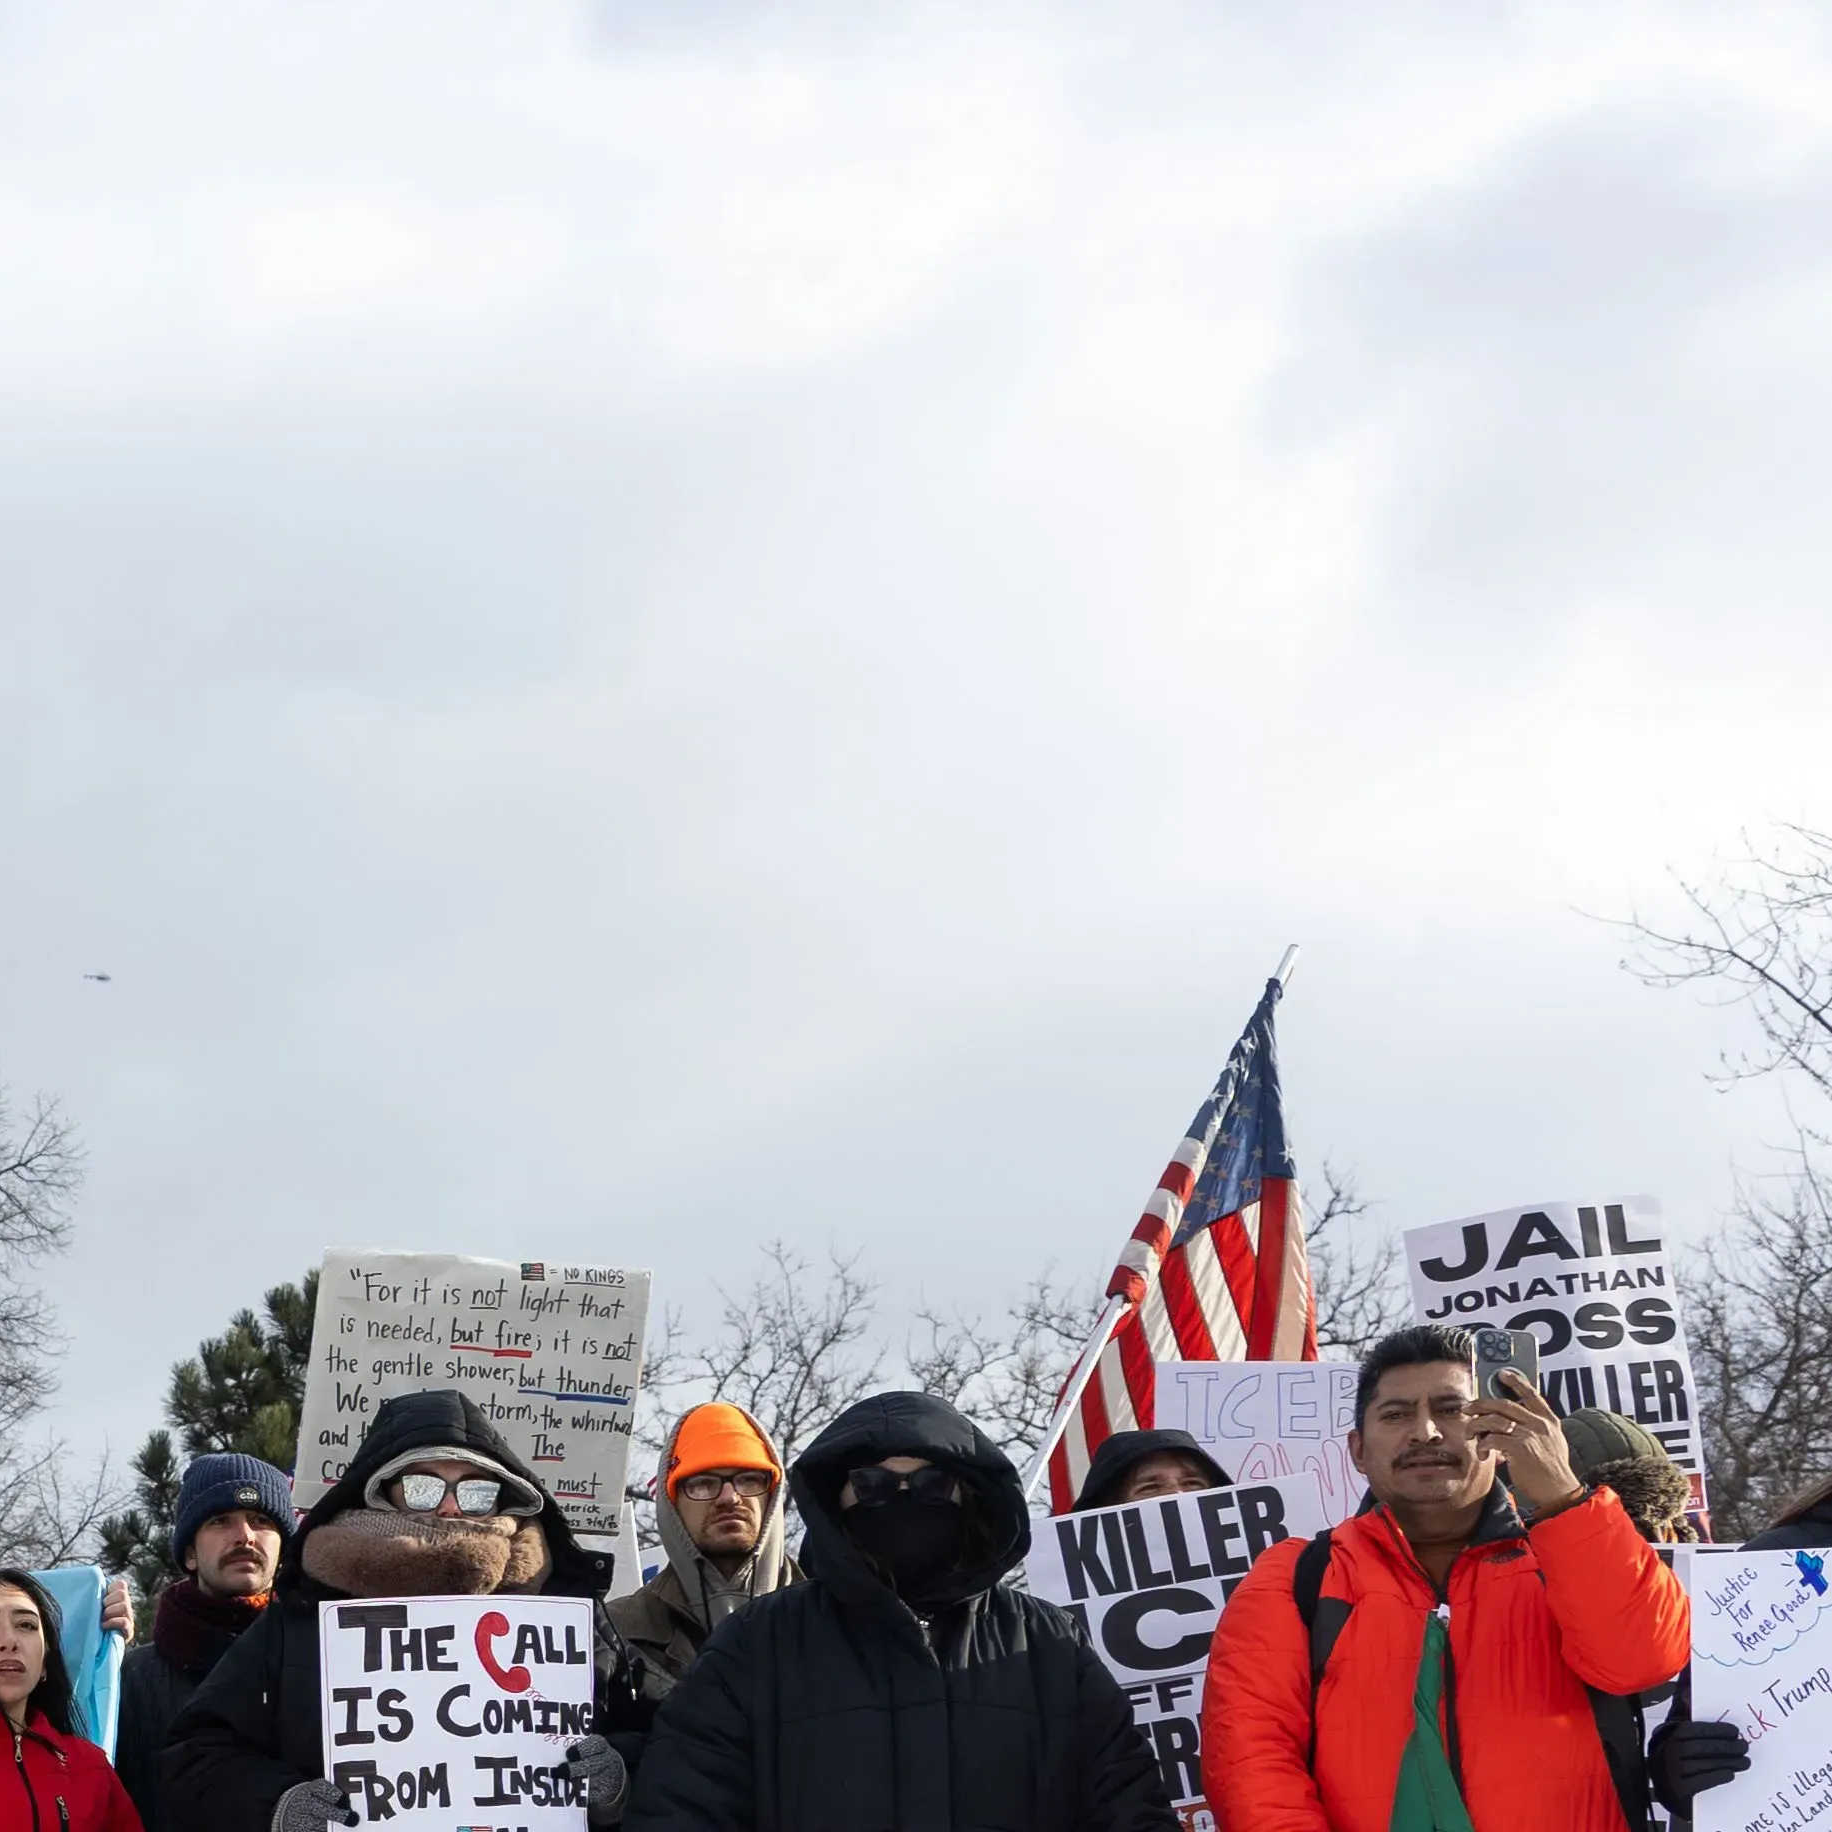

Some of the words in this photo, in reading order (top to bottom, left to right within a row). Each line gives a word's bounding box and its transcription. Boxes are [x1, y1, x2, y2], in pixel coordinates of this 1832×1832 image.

[1419, 1204, 1662, 1283] JAIL
[413, 1277, 432, 1305] it
[443, 1284, 461, 1305] is
[470, 1278, 508, 1306] not
[519, 1283, 569, 1322] light
[578, 1293, 625, 1320] that
[564, 1267, 580, 1281] NO
[585, 1268, 625, 1285] KINGS
[1425, 1266, 1666, 1319] JONATHAN
[340, 1313, 356, 1333] is
[367, 1315, 442, 1344] needed,
[451, 1317, 484, 1344] but
[552, 1327, 570, 1354] it
[582, 1335, 598, 1355] is
[603, 1332, 638, 1359] not
[1457, 1297, 1676, 1359] OSS
[326, 1344, 359, 1374] the
[372, 1352, 434, 1386] gentle
[445, 1354, 515, 1384] shower,
[518, 1364, 546, 1390] but
[336, 1383, 369, 1414] We
[541, 1409, 563, 1430] the
[318, 1425, 349, 1447] and
[532, 1434, 565, 1457] The
[557, 1471, 603, 1497] must
[1055, 1485, 1290, 1601] KILLER
[1705, 1567, 1758, 1616] Justice
[1726, 1600, 1754, 1628] For
[1732, 1619, 1776, 1652] Renee
[1771, 1591, 1810, 1623] Good
[337, 1604, 458, 1672] THE
[475, 1611, 587, 1693] CALL
[333, 1687, 414, 1746] IS
[436, 1683, 592, 1737] COMING
[1762, 1667, 1832, 1717] Trump
[333, 1760, 452, 1822] FROM
[1768, 1791, 1791, 1815] is
